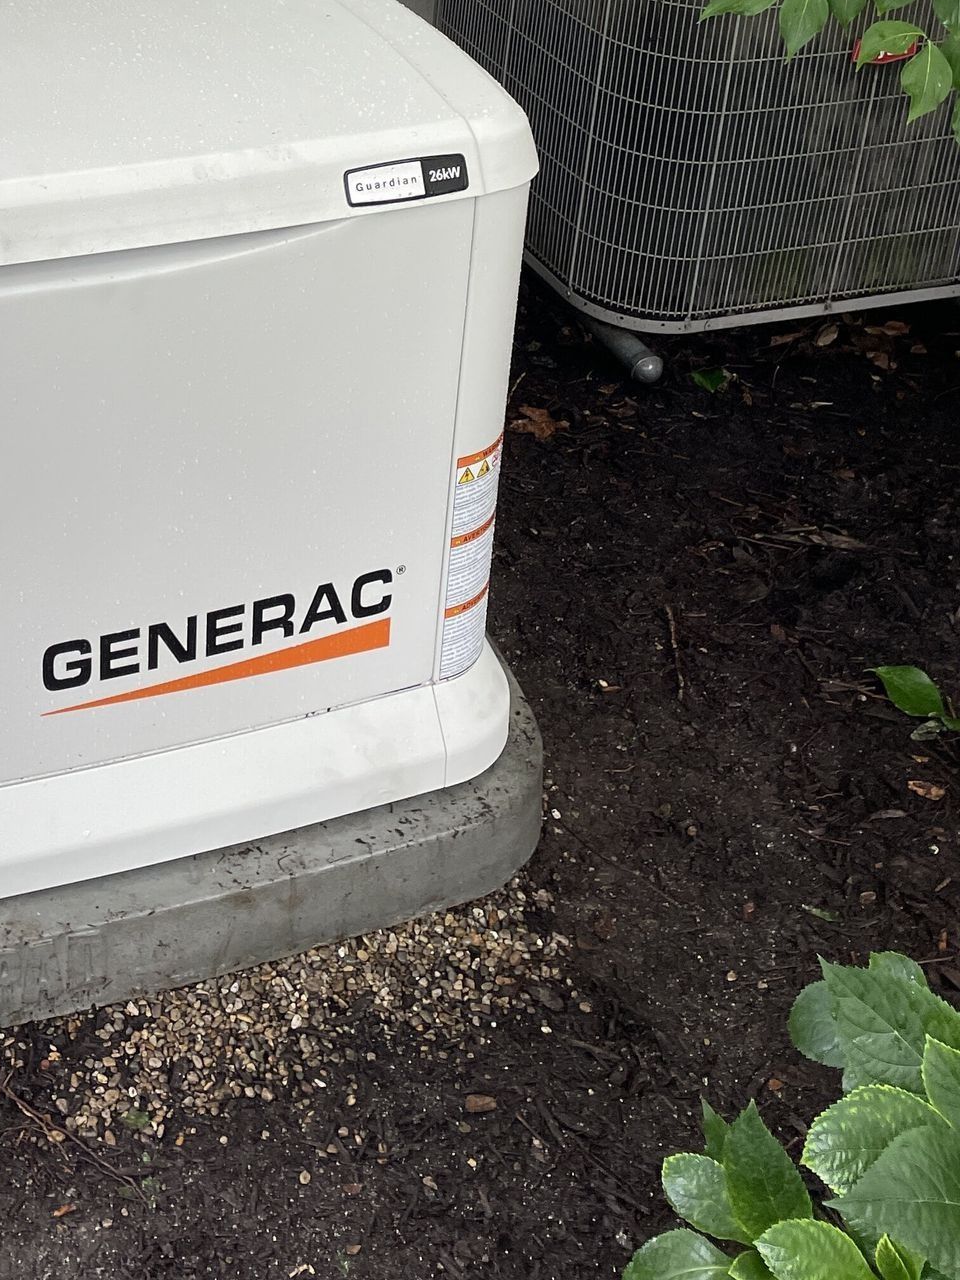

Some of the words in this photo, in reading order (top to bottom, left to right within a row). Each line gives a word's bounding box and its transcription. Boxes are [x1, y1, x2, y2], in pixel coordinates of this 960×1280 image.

[355, 176, 418, 192] Guardian
[428, 166, 461, 183] 26kW
[41, 567, 393, 692] GENERAC
